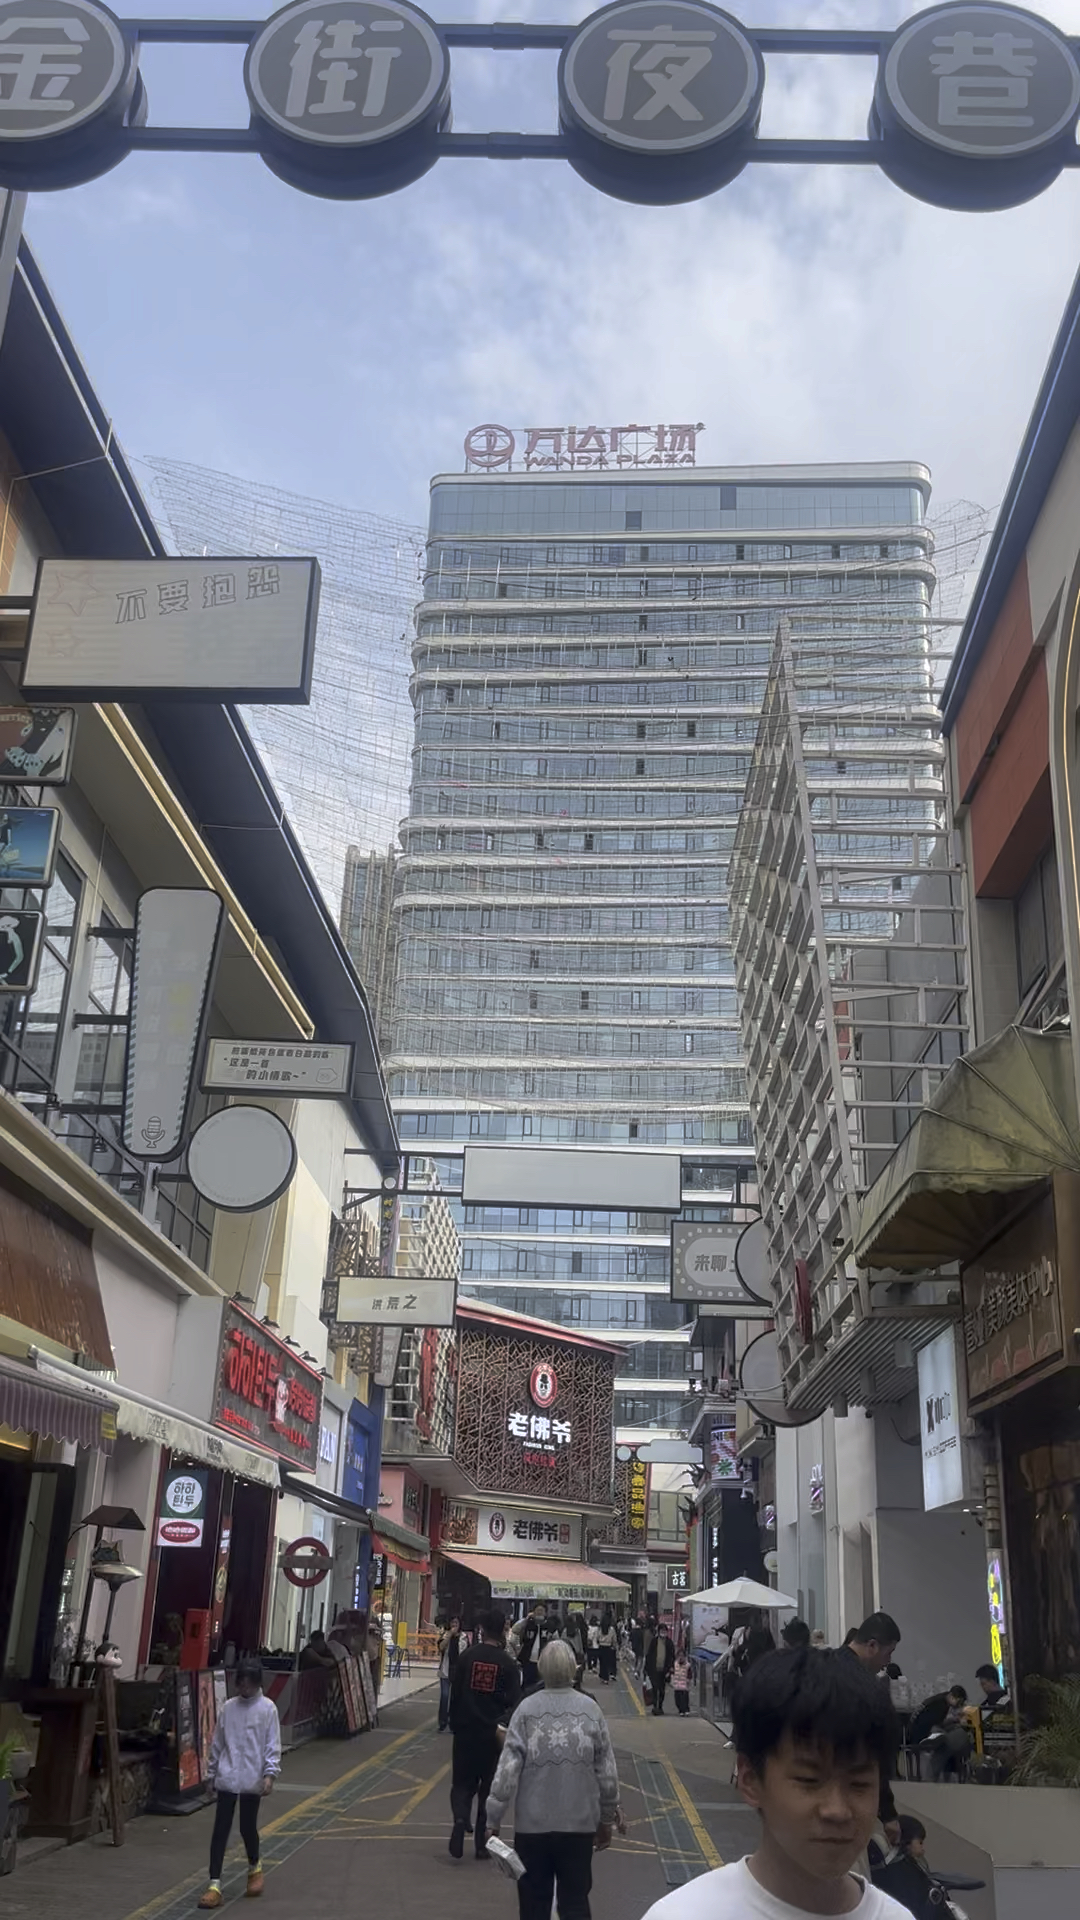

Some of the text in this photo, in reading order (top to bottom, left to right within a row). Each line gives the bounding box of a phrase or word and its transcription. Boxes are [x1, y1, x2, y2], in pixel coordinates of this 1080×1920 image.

[0, 19, 1036, 128] 金街夜巷
[524, 423, 697, 455] 万达广场
[523, 453, 696, 466] WANDA PLAZA
[115, 564, 281, 624] 不要抱怨
[371, 1293, 418, 1311] 洪荒之
[507, 1411, 572, 1444] 老佛爷
[173, 1482, 196, 1495] 하하
[512, 1518, 559, 1543] 老佛爷
